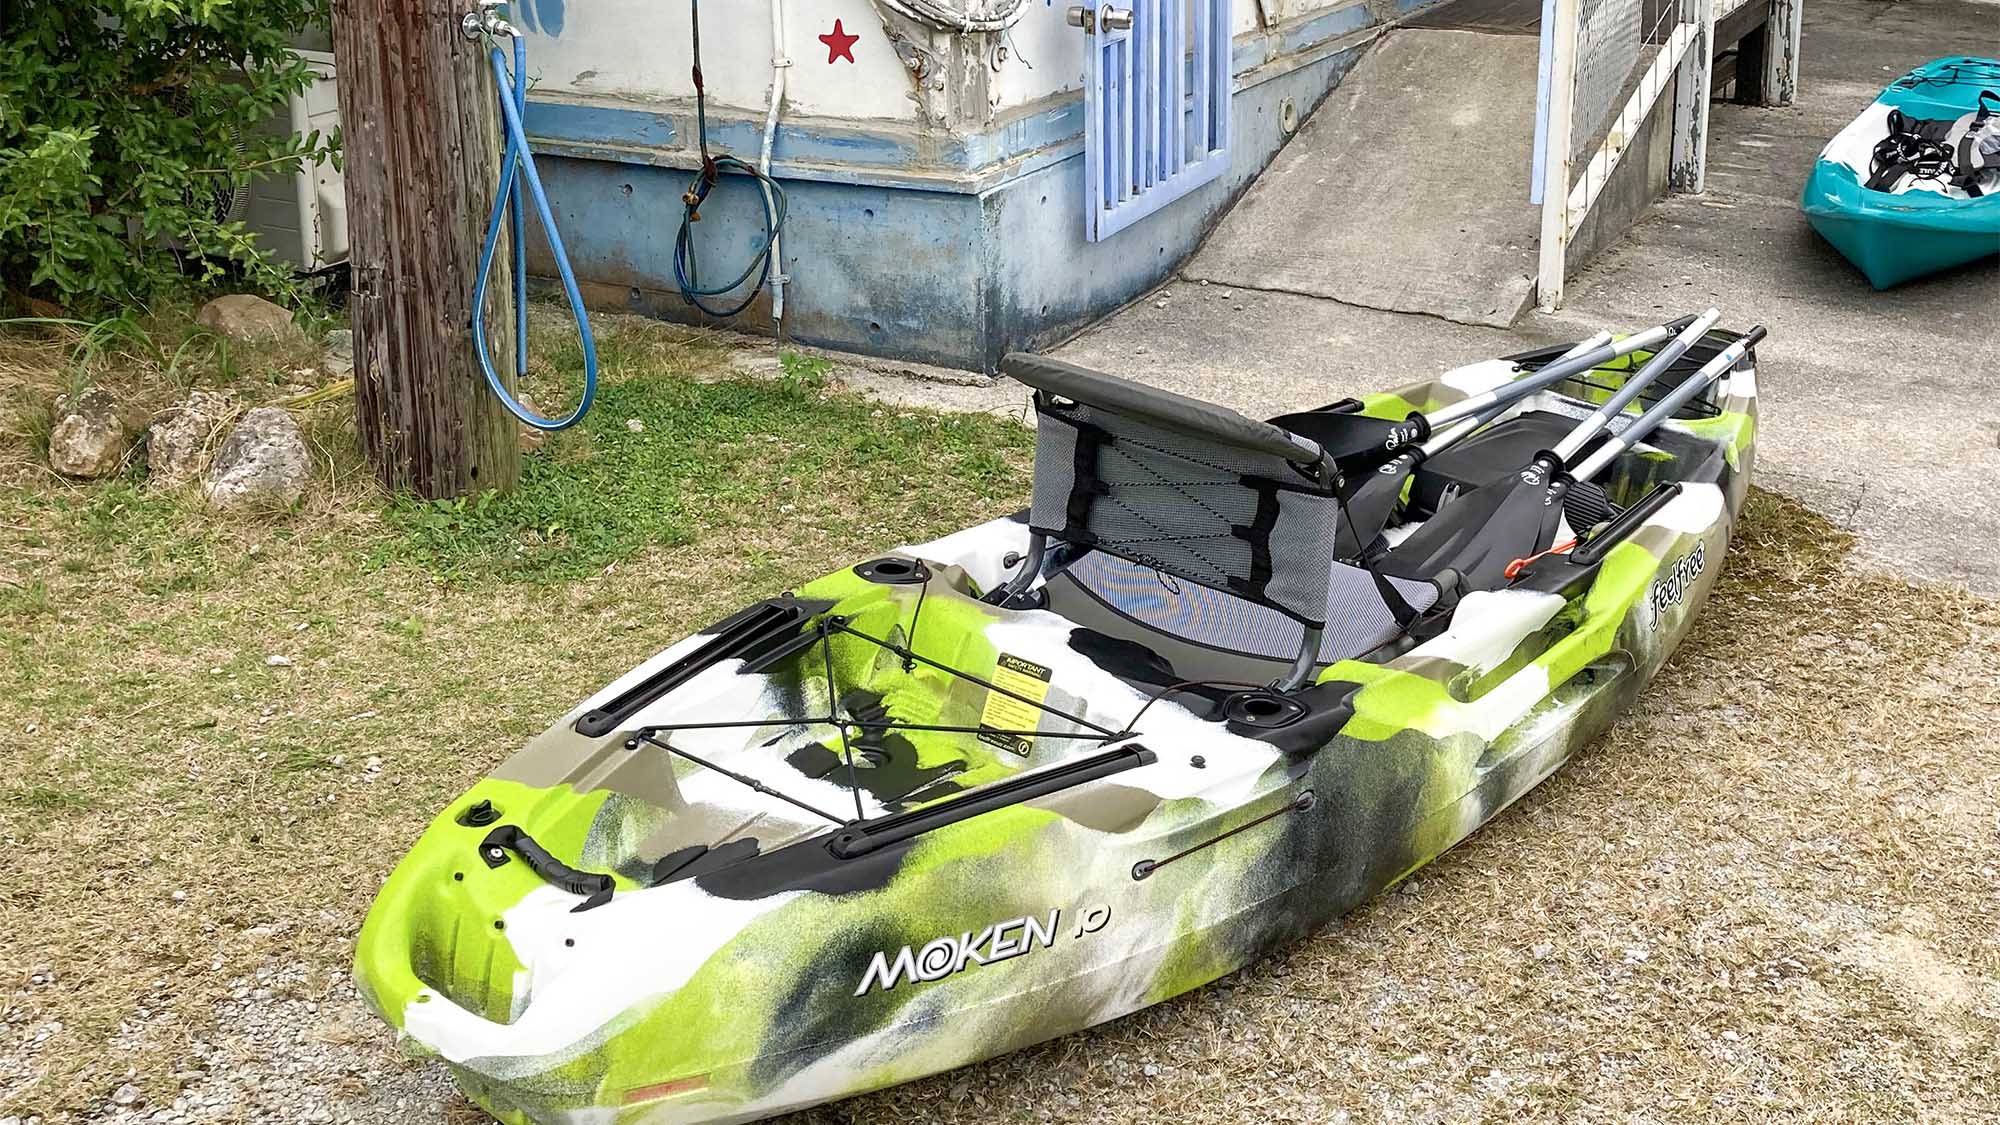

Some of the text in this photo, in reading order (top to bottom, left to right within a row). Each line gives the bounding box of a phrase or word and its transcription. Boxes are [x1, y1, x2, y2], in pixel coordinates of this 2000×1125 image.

[1649, 539, 1705, 632] feelfree
[853, 903, 1111, 998] MOKEN 10
